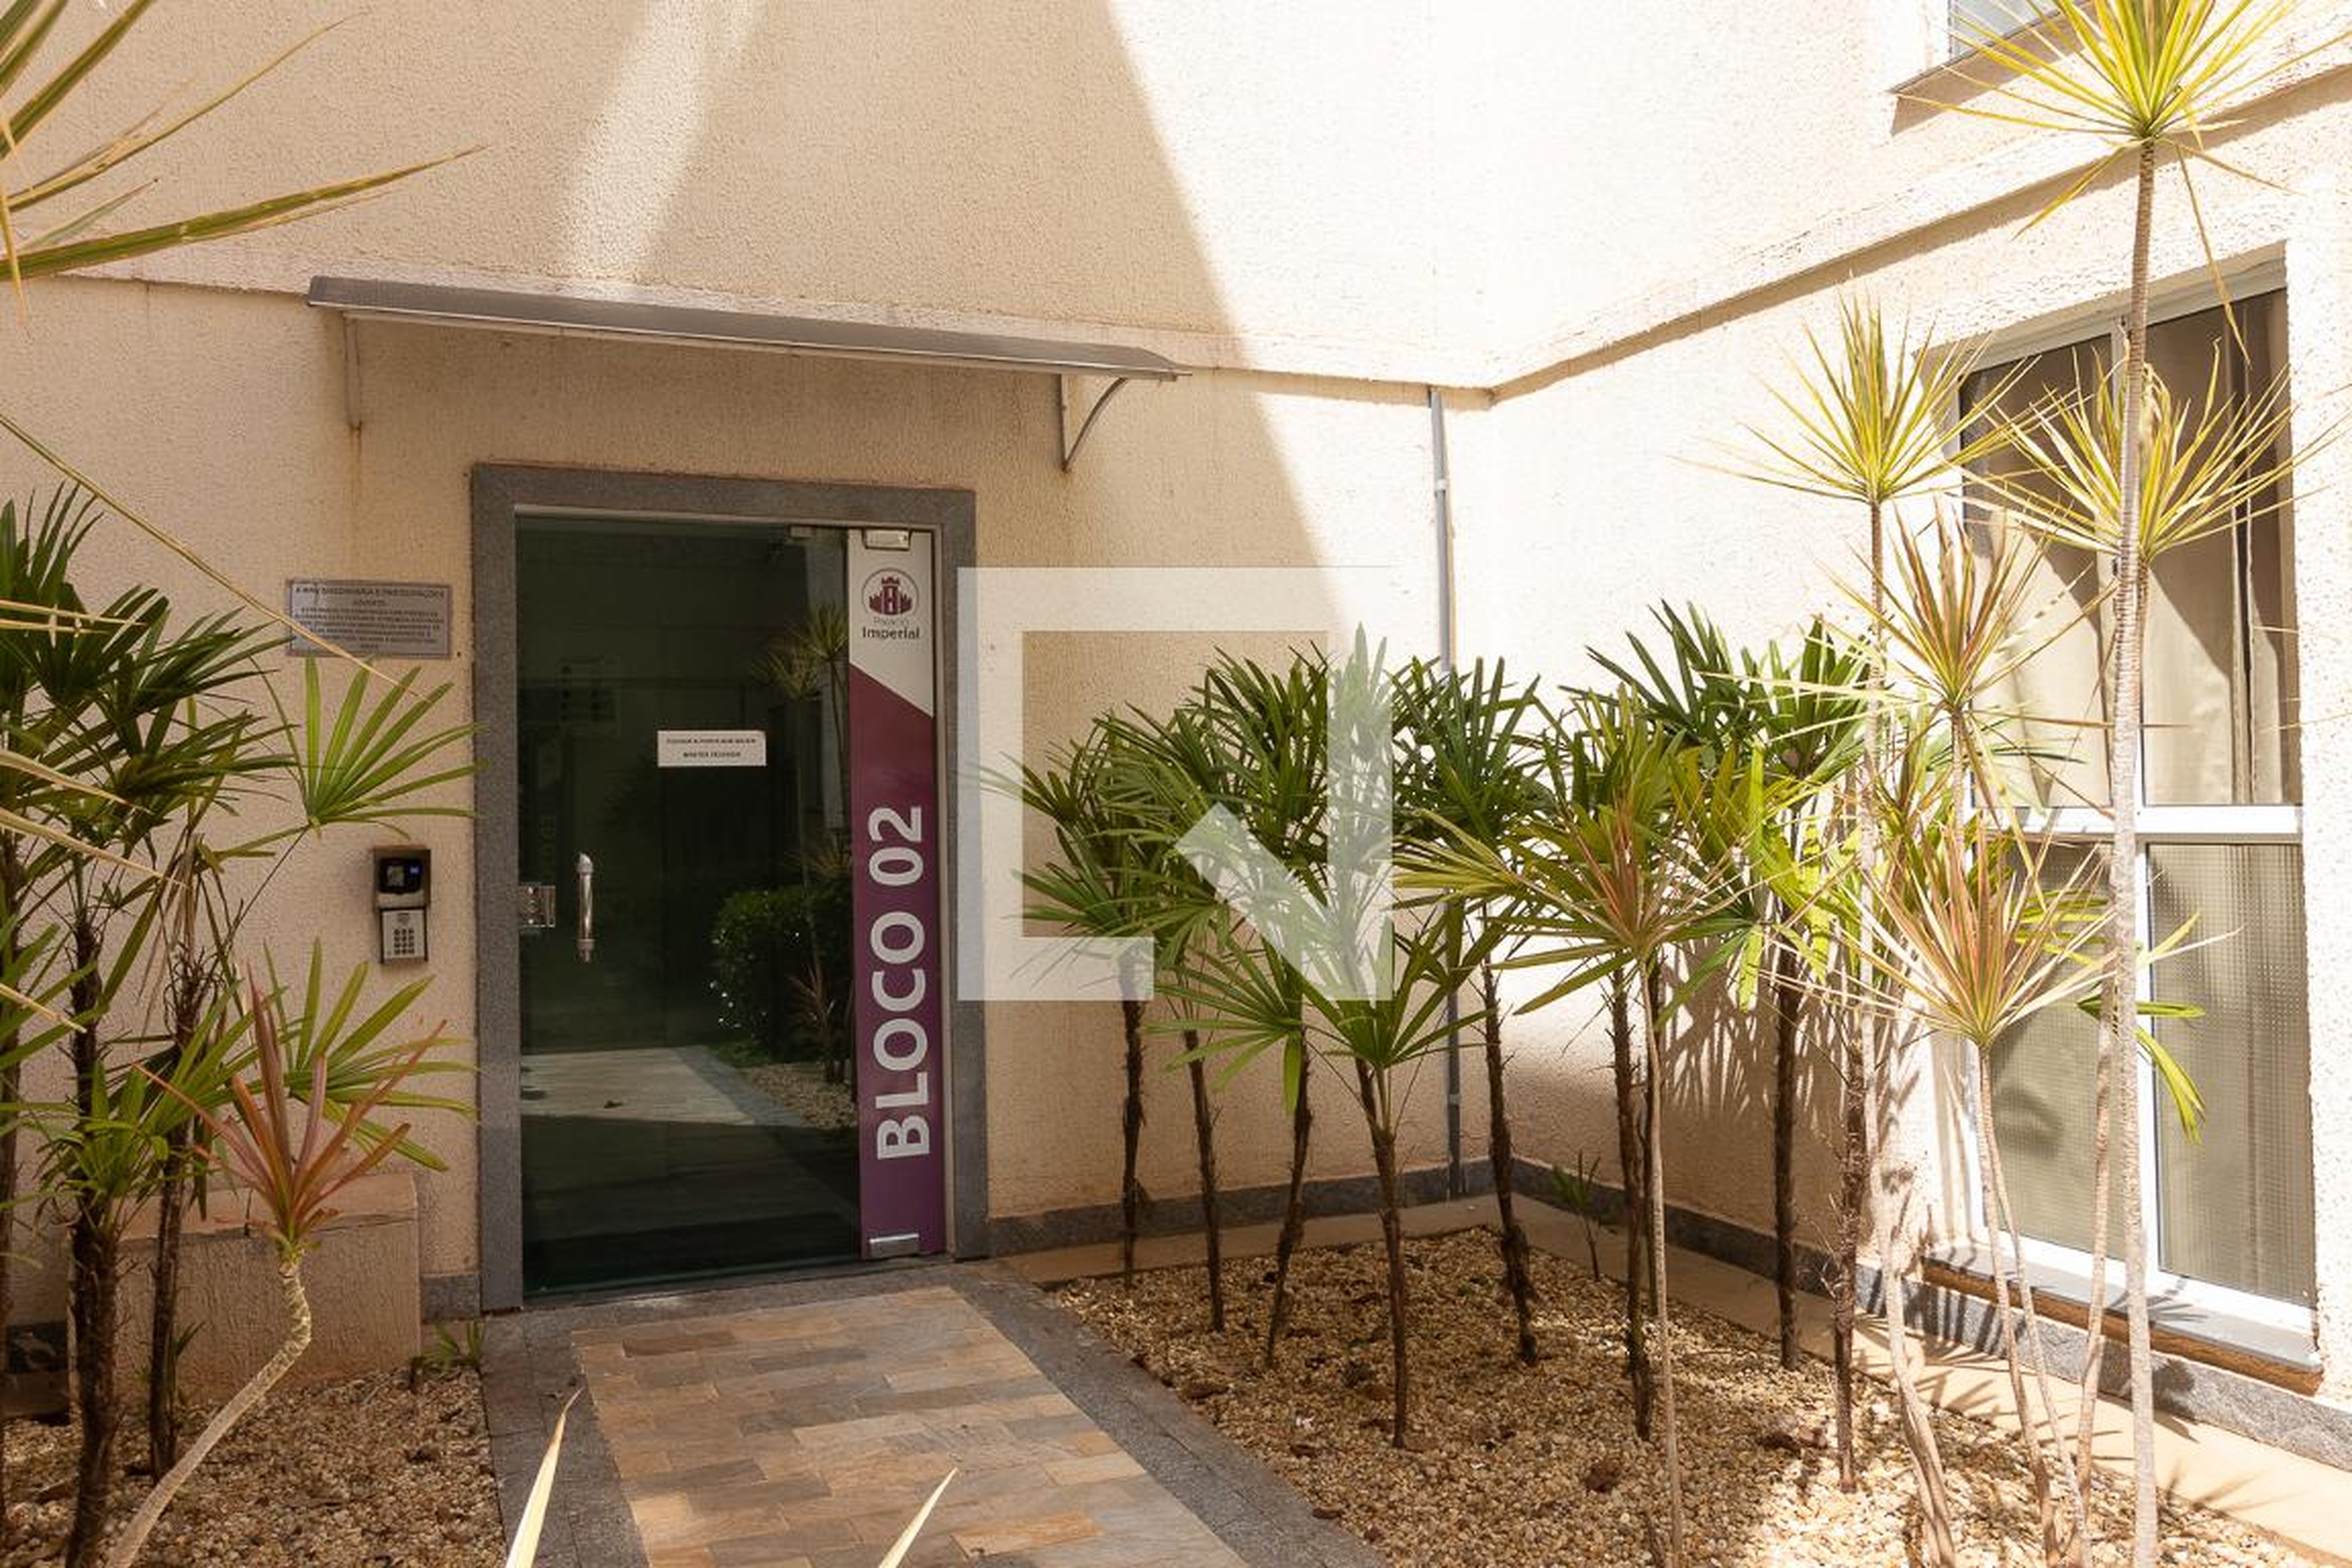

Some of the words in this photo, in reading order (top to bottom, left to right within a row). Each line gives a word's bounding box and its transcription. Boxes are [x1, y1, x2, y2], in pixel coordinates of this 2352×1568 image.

[862, 626, 920, 641] Imperial
[868, 807, 924, 886] 02
[870, 911, 930, 1160] BLOCO
